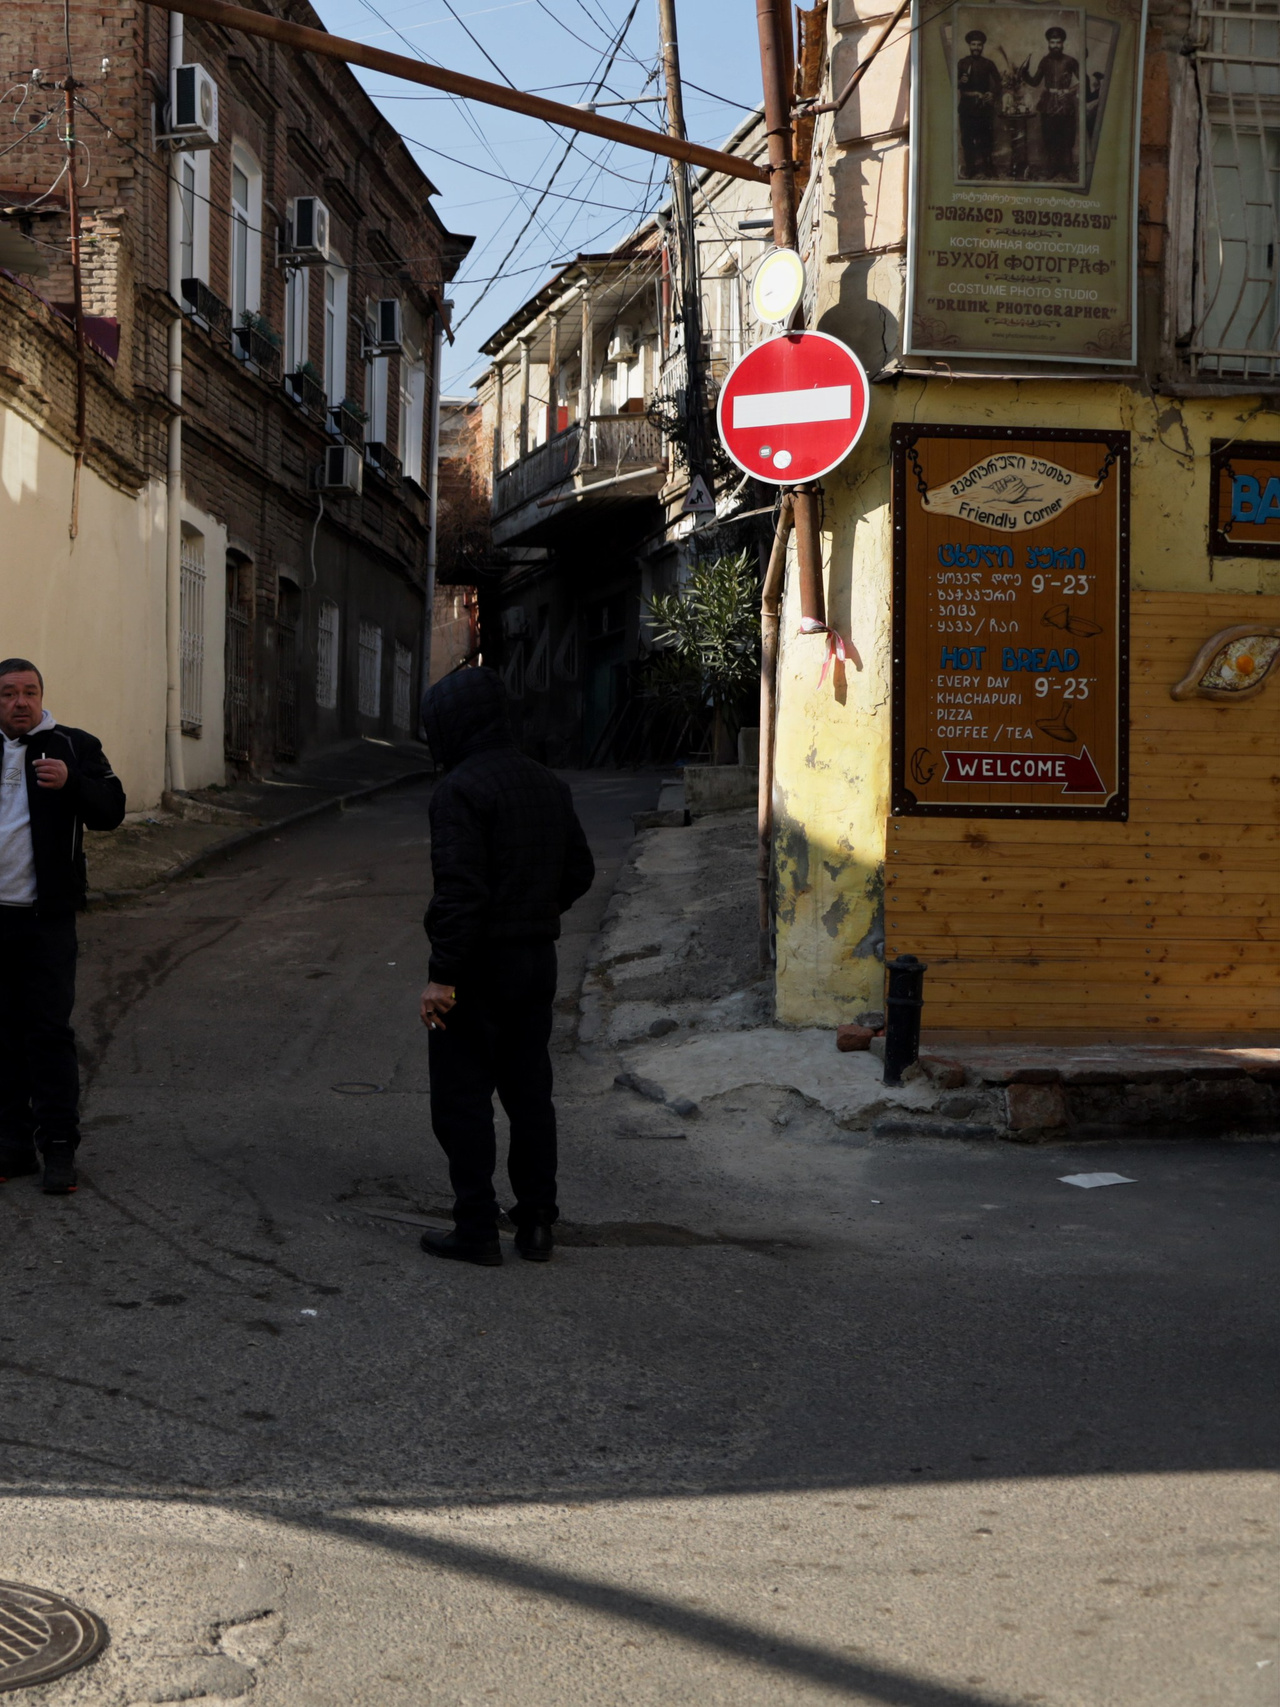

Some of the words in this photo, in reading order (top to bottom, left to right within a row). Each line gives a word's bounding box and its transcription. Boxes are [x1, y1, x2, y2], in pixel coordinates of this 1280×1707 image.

[950, 236, 1022, 250] КОСТЮМНАЯ
[1025, 241, 1100, 255] ФОТОСТУДИЯ
[948, 282, 1007, 297] COSTUME
[1009, 286, 1051, 299] PHOTO
[1054, 288, 1098, 301] STUDIO
[959, 502, 1017, 529] Friendly
[1024, 498, 1062, 525] Corner
[937, 543, 1015, 568] ცხელი
[1024, 546, 1086, 569] პური
[937, 573, 982, 585] ყოველ
[991, 573, 1022, 587] დღე
[937, 589, 1016, 601] ხაჭაპური
[938, 604, 977, 617] პიცა
[940, 646, 986, 670] HOT
[1001, 647, 1080, 672] BREAD
[937, 675, 981, 688] EVERY
[987, 676, 1010, 688] DAY
[936, 693, 1022, 705] KHACHAPURI
[936, 709, 973, 721] PIZZA
[937, 726, 989, 739] COFFEE
[956, 758, 1067, 778] WELCOME
